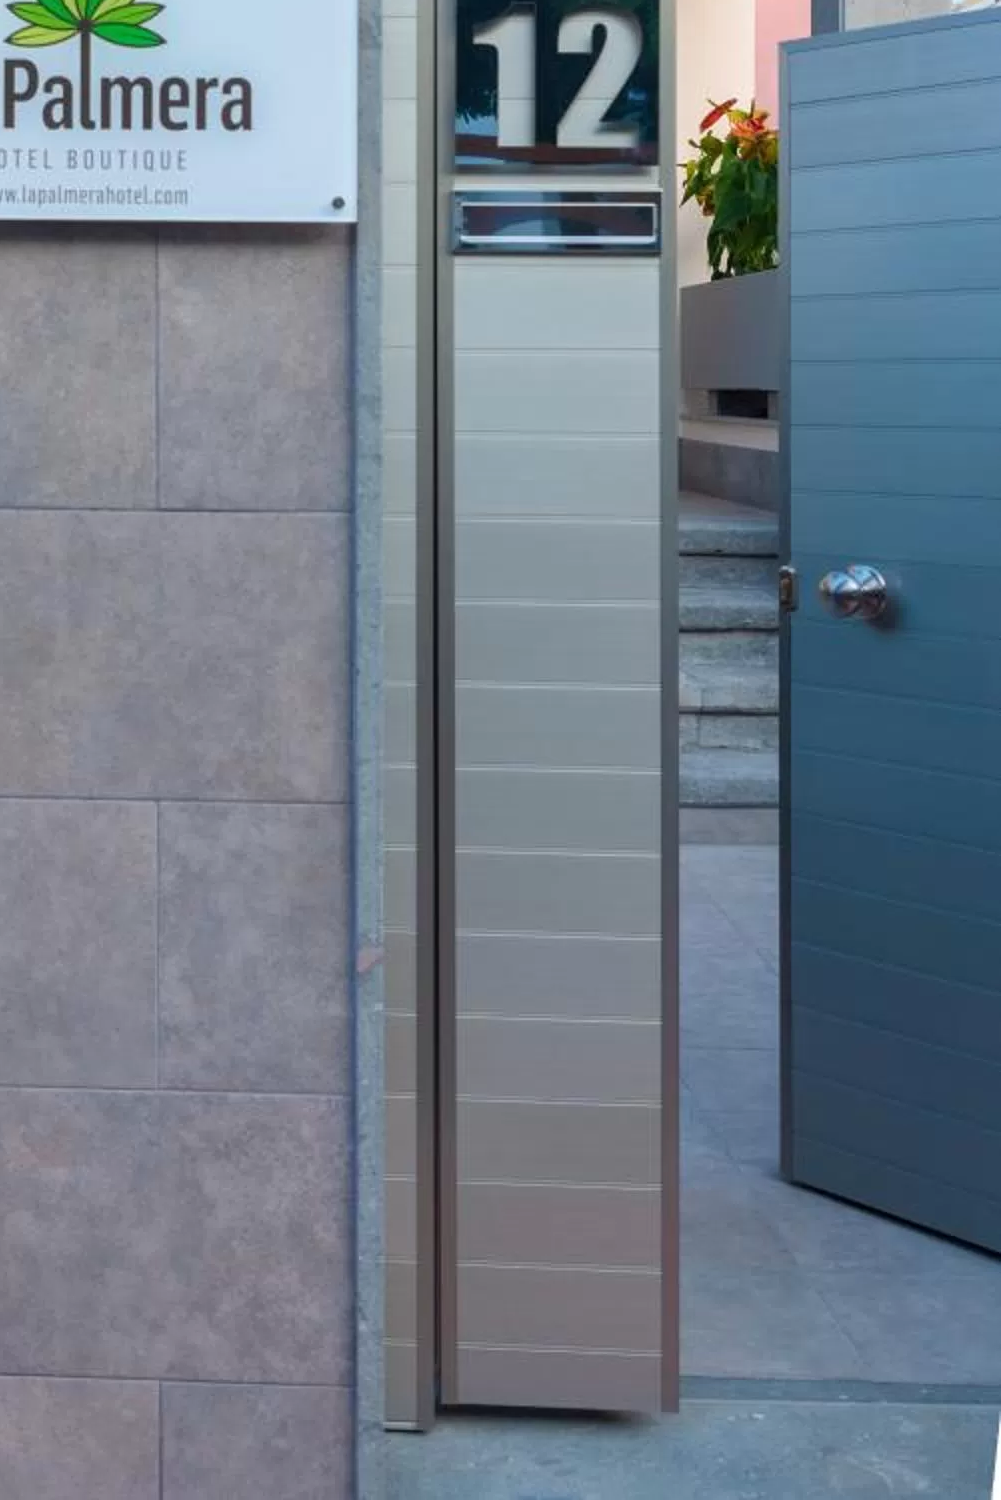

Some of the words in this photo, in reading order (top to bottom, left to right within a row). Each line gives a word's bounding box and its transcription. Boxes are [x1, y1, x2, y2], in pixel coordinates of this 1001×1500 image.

[3, 41, 253, 131] Palmera
[473, 8, 641, 147] 12
[66, 149, 188, 172] BOUTIQUE
